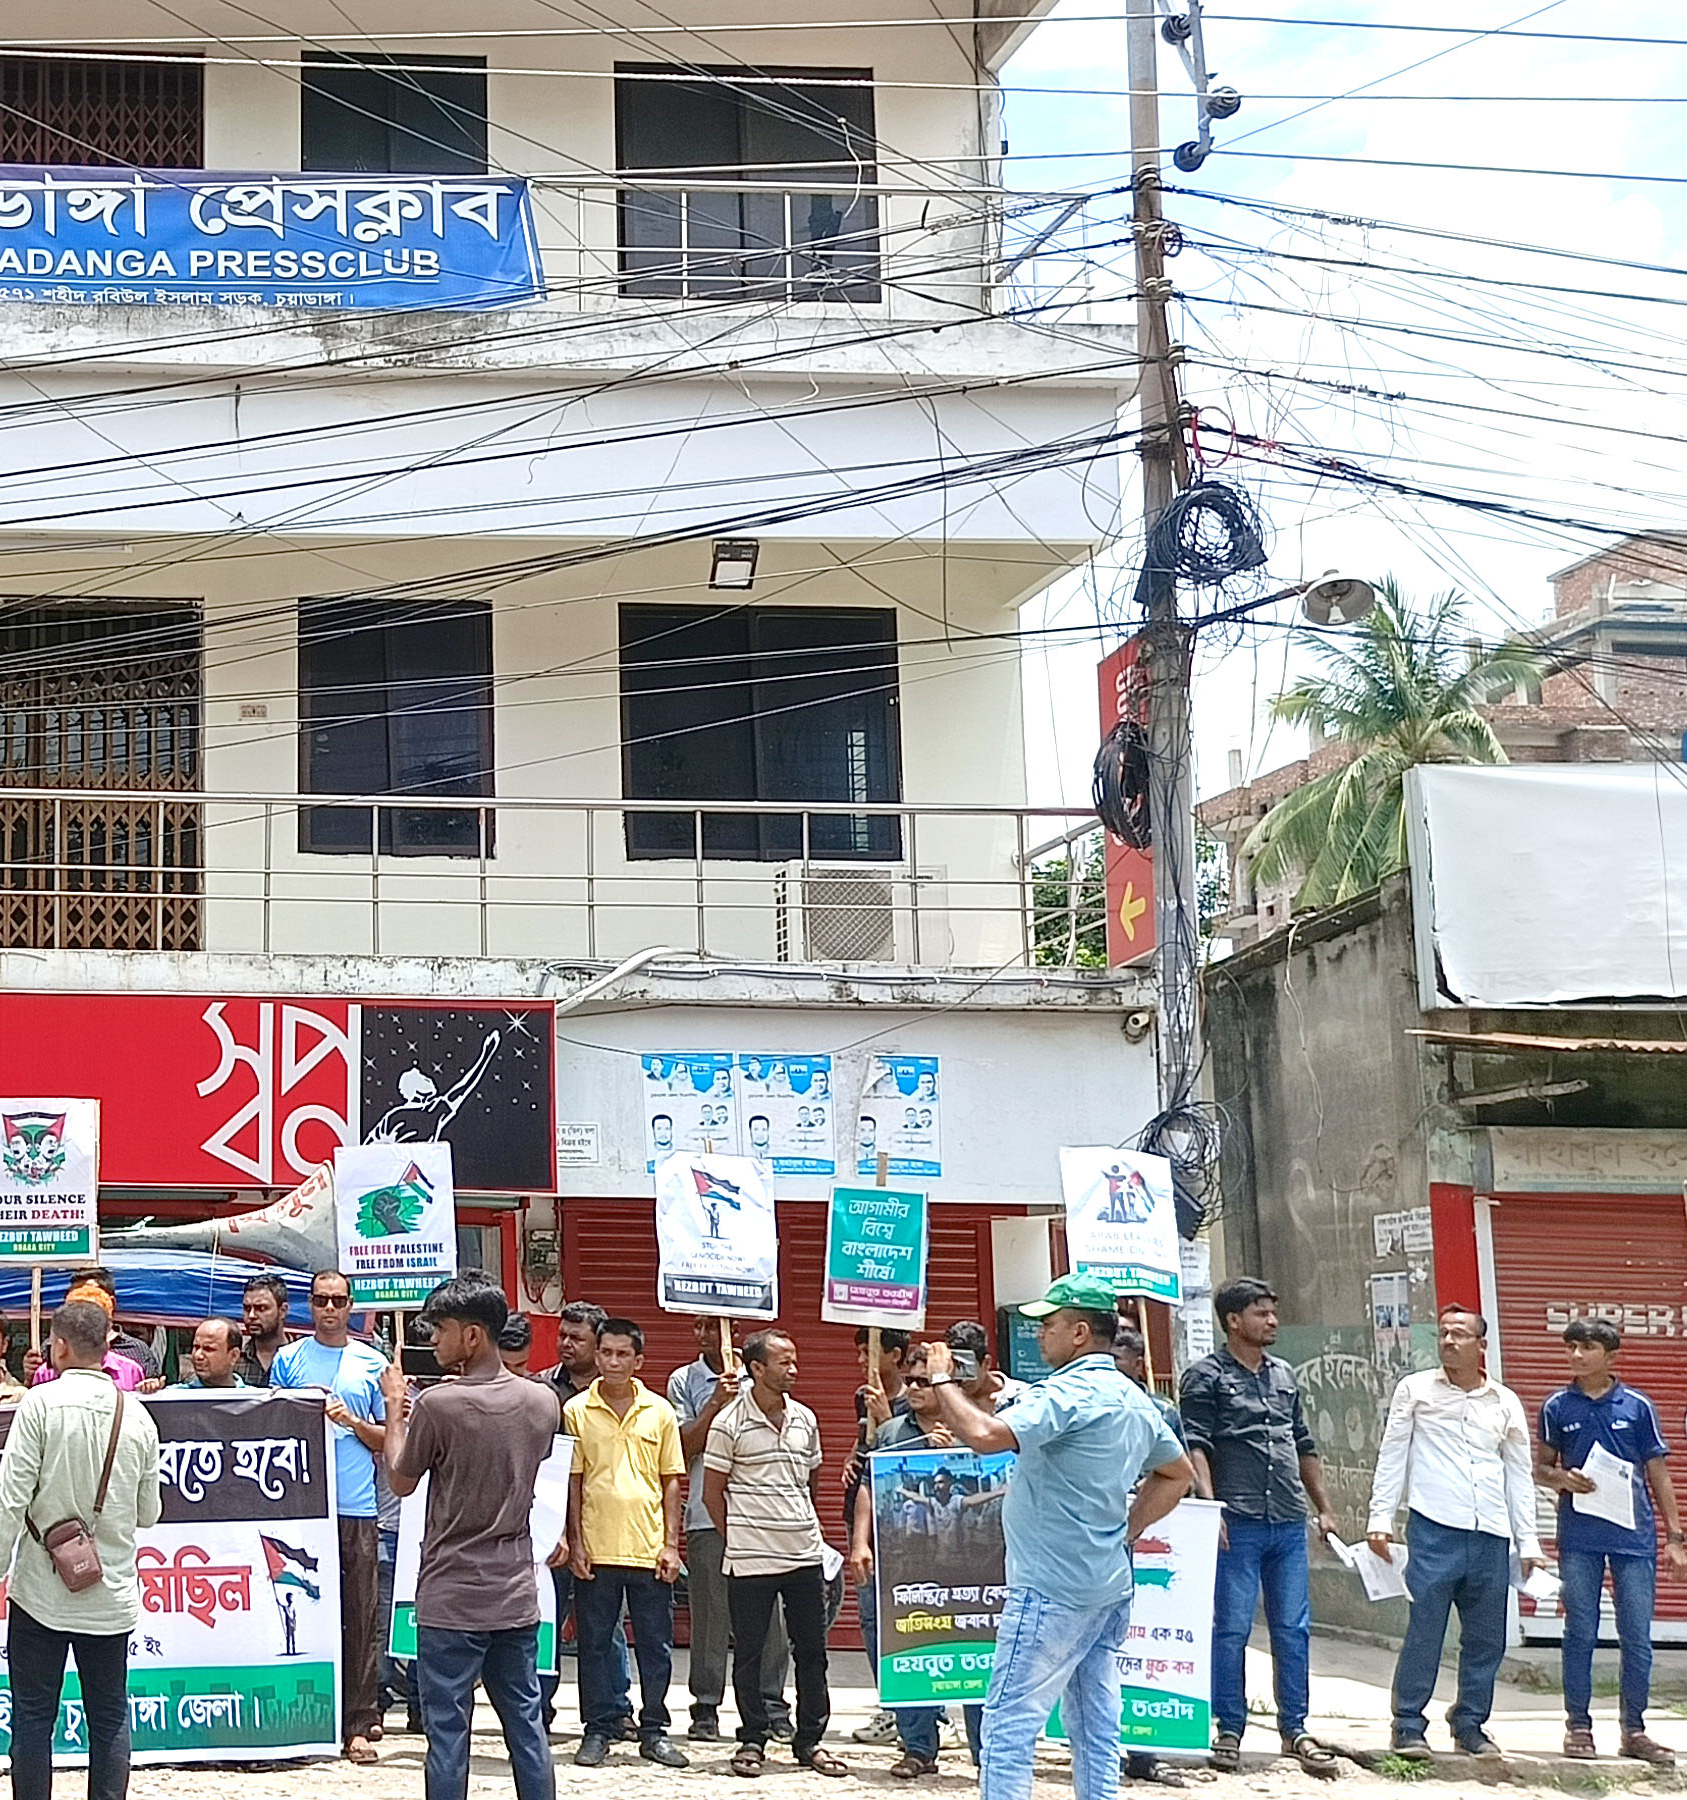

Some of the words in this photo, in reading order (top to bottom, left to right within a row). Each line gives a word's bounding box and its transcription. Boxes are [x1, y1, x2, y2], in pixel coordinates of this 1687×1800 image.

[190, 176, 513, 242] প্রেসক্লাব
[190, 250, 440, 278] PRESSCLUB
[41, 287, 87, 304] শহীদ
[91, 286, 148, 305] রবিউল
[155, 288, 213, 305] ইসলাম
[26, 1194, 86, 1204] SILENCE
[848, 1197, 910, 1219] আগামীর
[31, 1210, 85, 1219] DEATH!
[30, 1230, 79, 1242] TAWHEED
[861, 1217, 895, 1240] বিশ্বে
[349, 1245, 369, 1256] FREE
[371, 1244, 392, 1255] FREE
[394, 1243, 444, 1254] PALESTINE
[841, 1240, 913, 1260] বাংলাদেশ
[356, 1259, 376, 1269] FREE
[377, 1258, 404, 1269] FROM
[354, 1278, 391, 1290] HEZBUT
[1546, 1302, 1674, 1337] SUPER
[230, 1437, 311, 1501] হবে!
[895, 1611, 952, 1633] জাতিসংঘ
[954, 1613, 989, 1630] জবাব
[1150, 1627, 1171, 1641] এক
[1175, 1628, 1194, 1643] হও
[893, 1654, 956, 1679] হেযবুত
[1146, 1658, 1169, 1681] মুক্ত
[1172, 1661, 1194, 1675] কর
[178, 1690, 244, 1730] জেলা
[1131, 1697, 1195, 1721] তওহীদ
